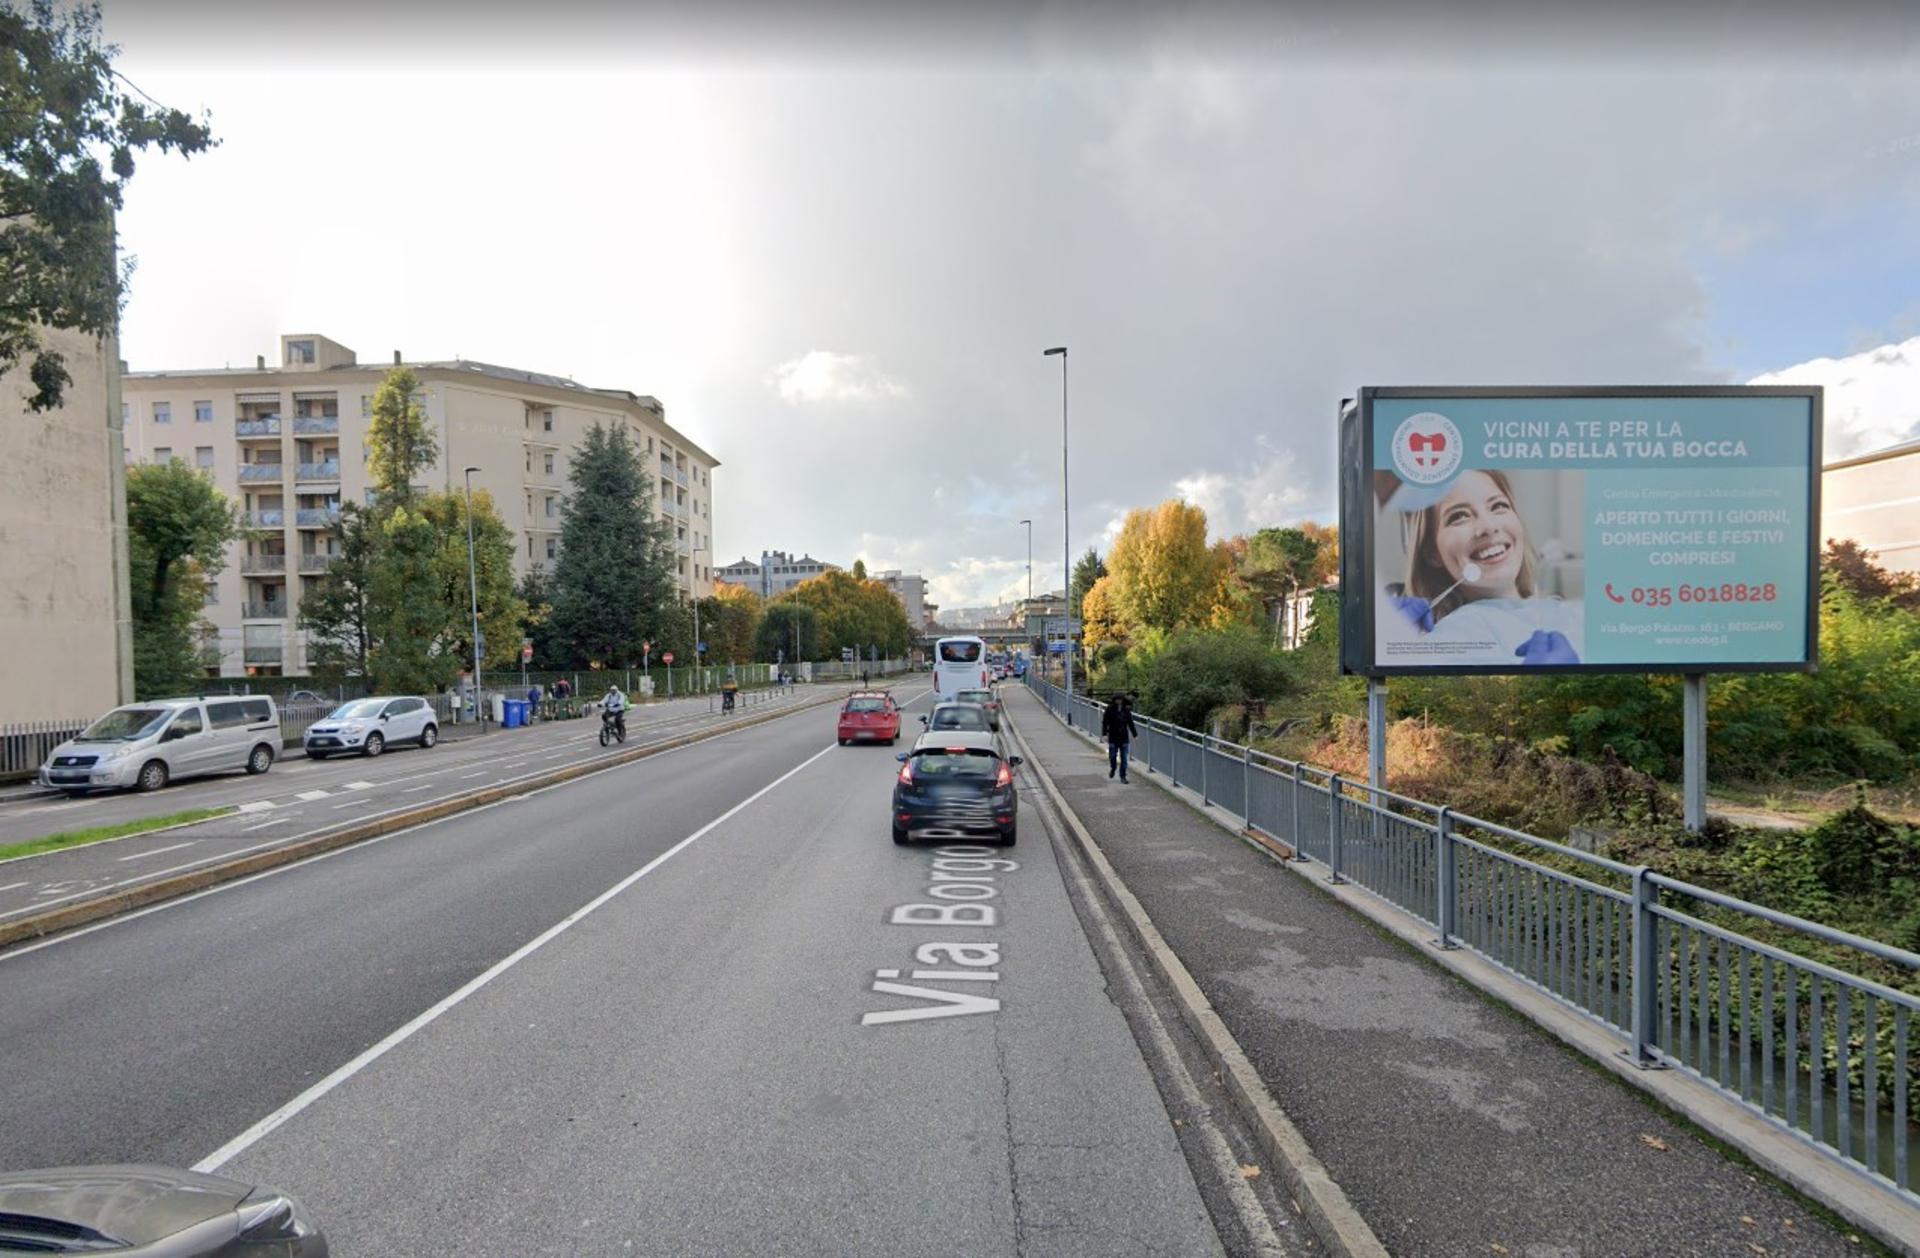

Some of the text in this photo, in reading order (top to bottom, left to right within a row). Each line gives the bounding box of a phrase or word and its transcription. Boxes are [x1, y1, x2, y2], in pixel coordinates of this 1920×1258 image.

[1483, 421, 1682, 438] VICINI A TE PER LA
[1483, 441, 1747, 458] CURA DELLA TUA BOCCA
[1594, 510, 1790, 525] APERTO TUTTI I GIORNI,
[1601, 530, 1783, 545] DOMENICHE E FESTIVI
[1649, 551, 1736, 566] COMPRESI
[1631, 583, 1777, 607] 035 6018828
[1600, 624, 1618, 633] Via
[1619, 623, 1652, 635] Borgo
[1728, 621, 1785, 633] BERGAMO
